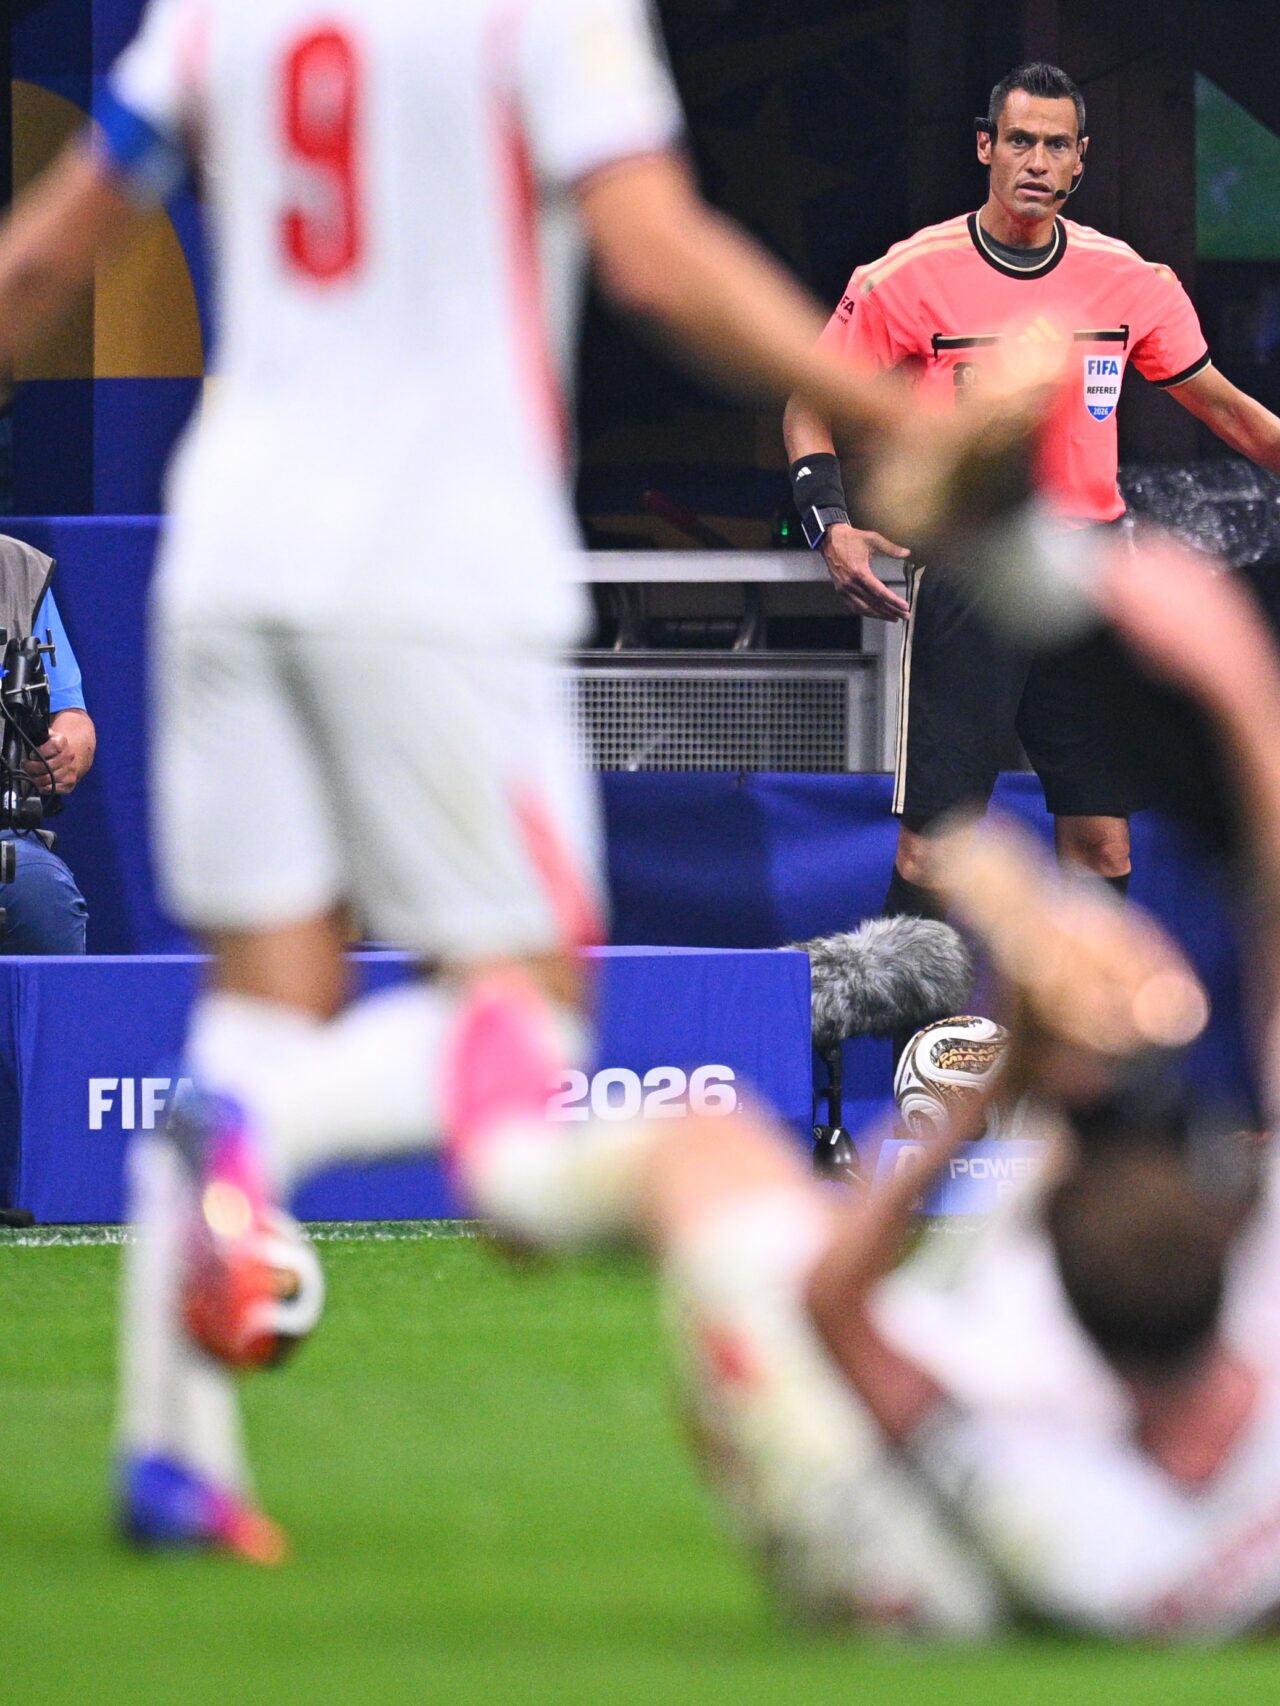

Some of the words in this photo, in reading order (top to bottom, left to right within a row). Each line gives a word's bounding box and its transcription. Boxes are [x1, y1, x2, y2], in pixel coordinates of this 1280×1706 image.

[283, 26, 361, 279] 9
[1088, 360, 1119, 375] FIFA
[1086, 385, 1117, 395] REFEREE
[1093, 406, 1109, 416] 2026
[941, 1054, 998, 1070] MIAM
[546, 1064, 737, 1121] 2026
